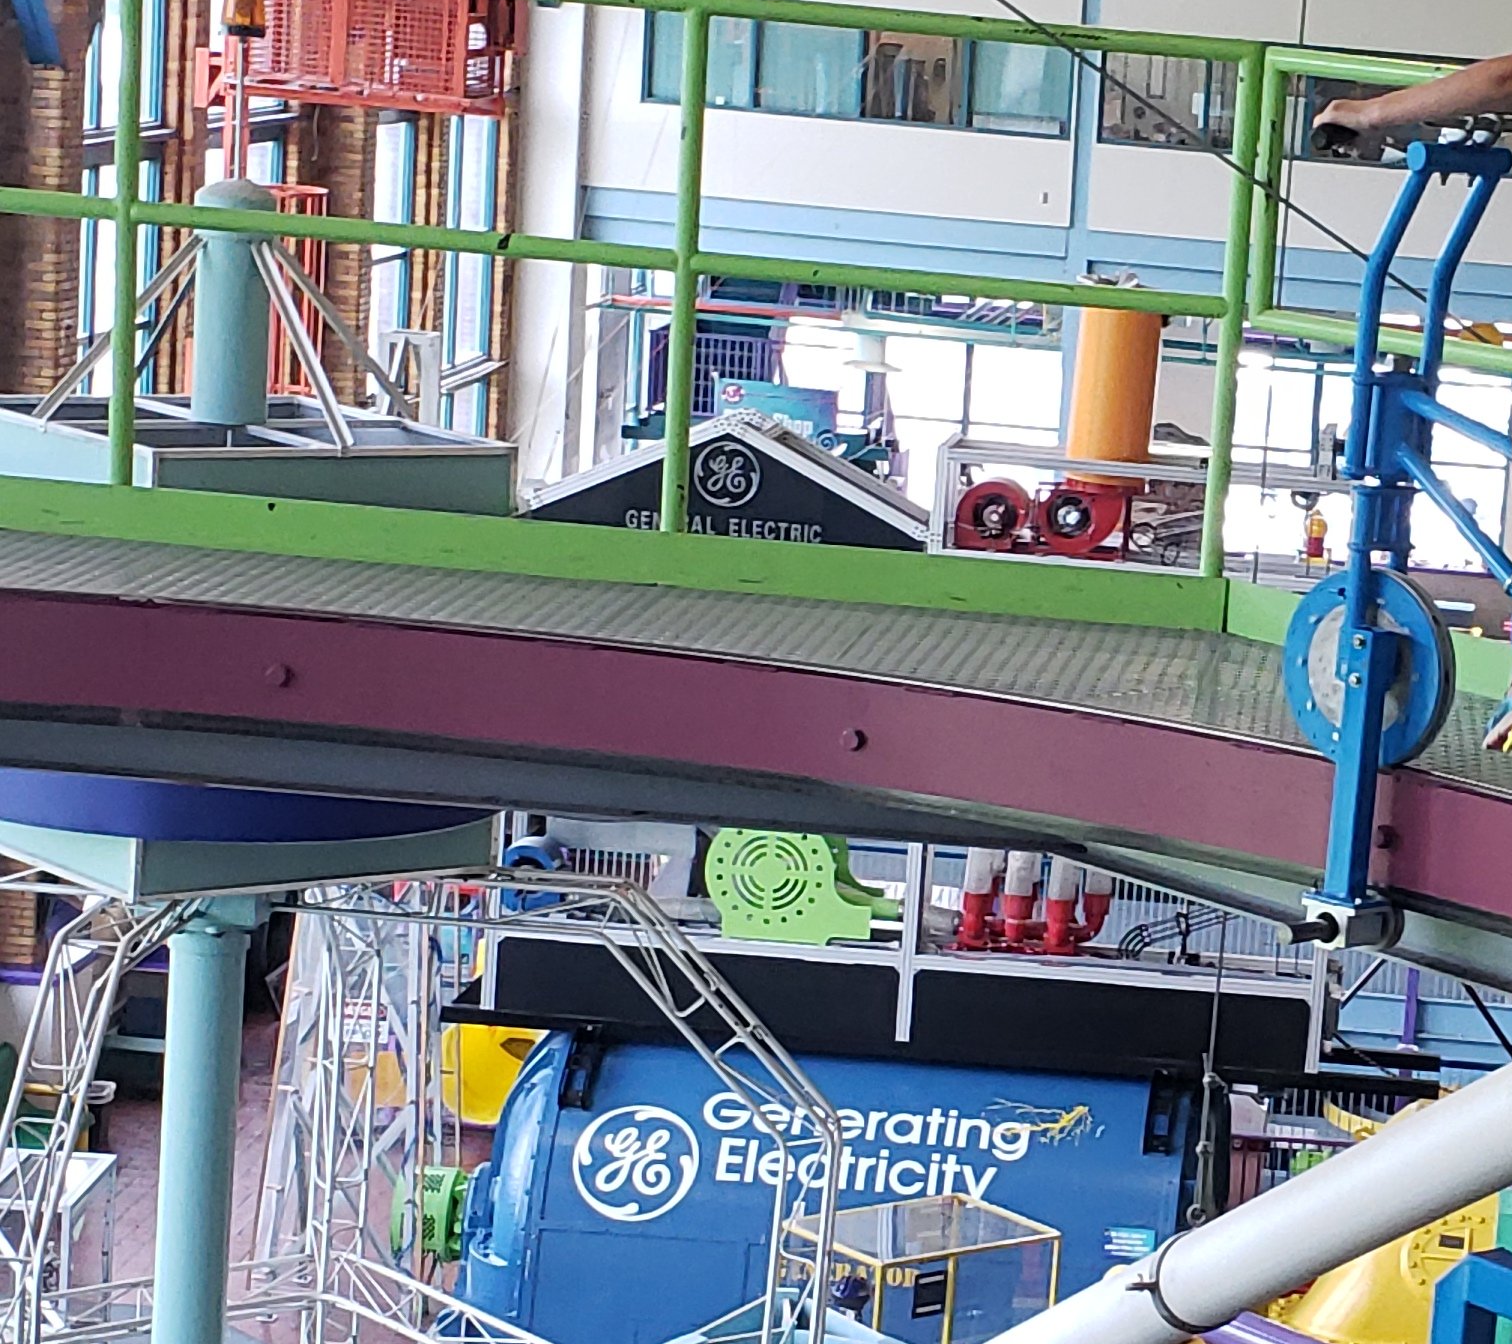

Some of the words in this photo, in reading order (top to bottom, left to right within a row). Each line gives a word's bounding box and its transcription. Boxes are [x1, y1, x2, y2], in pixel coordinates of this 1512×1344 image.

[625, 509, 716, 535] GENAL
[728, 518, 823, 544] ELECTRIC
[702, 1091, 1031, 1162] Generating
[714, 1137, 998, 1199] Electricity
